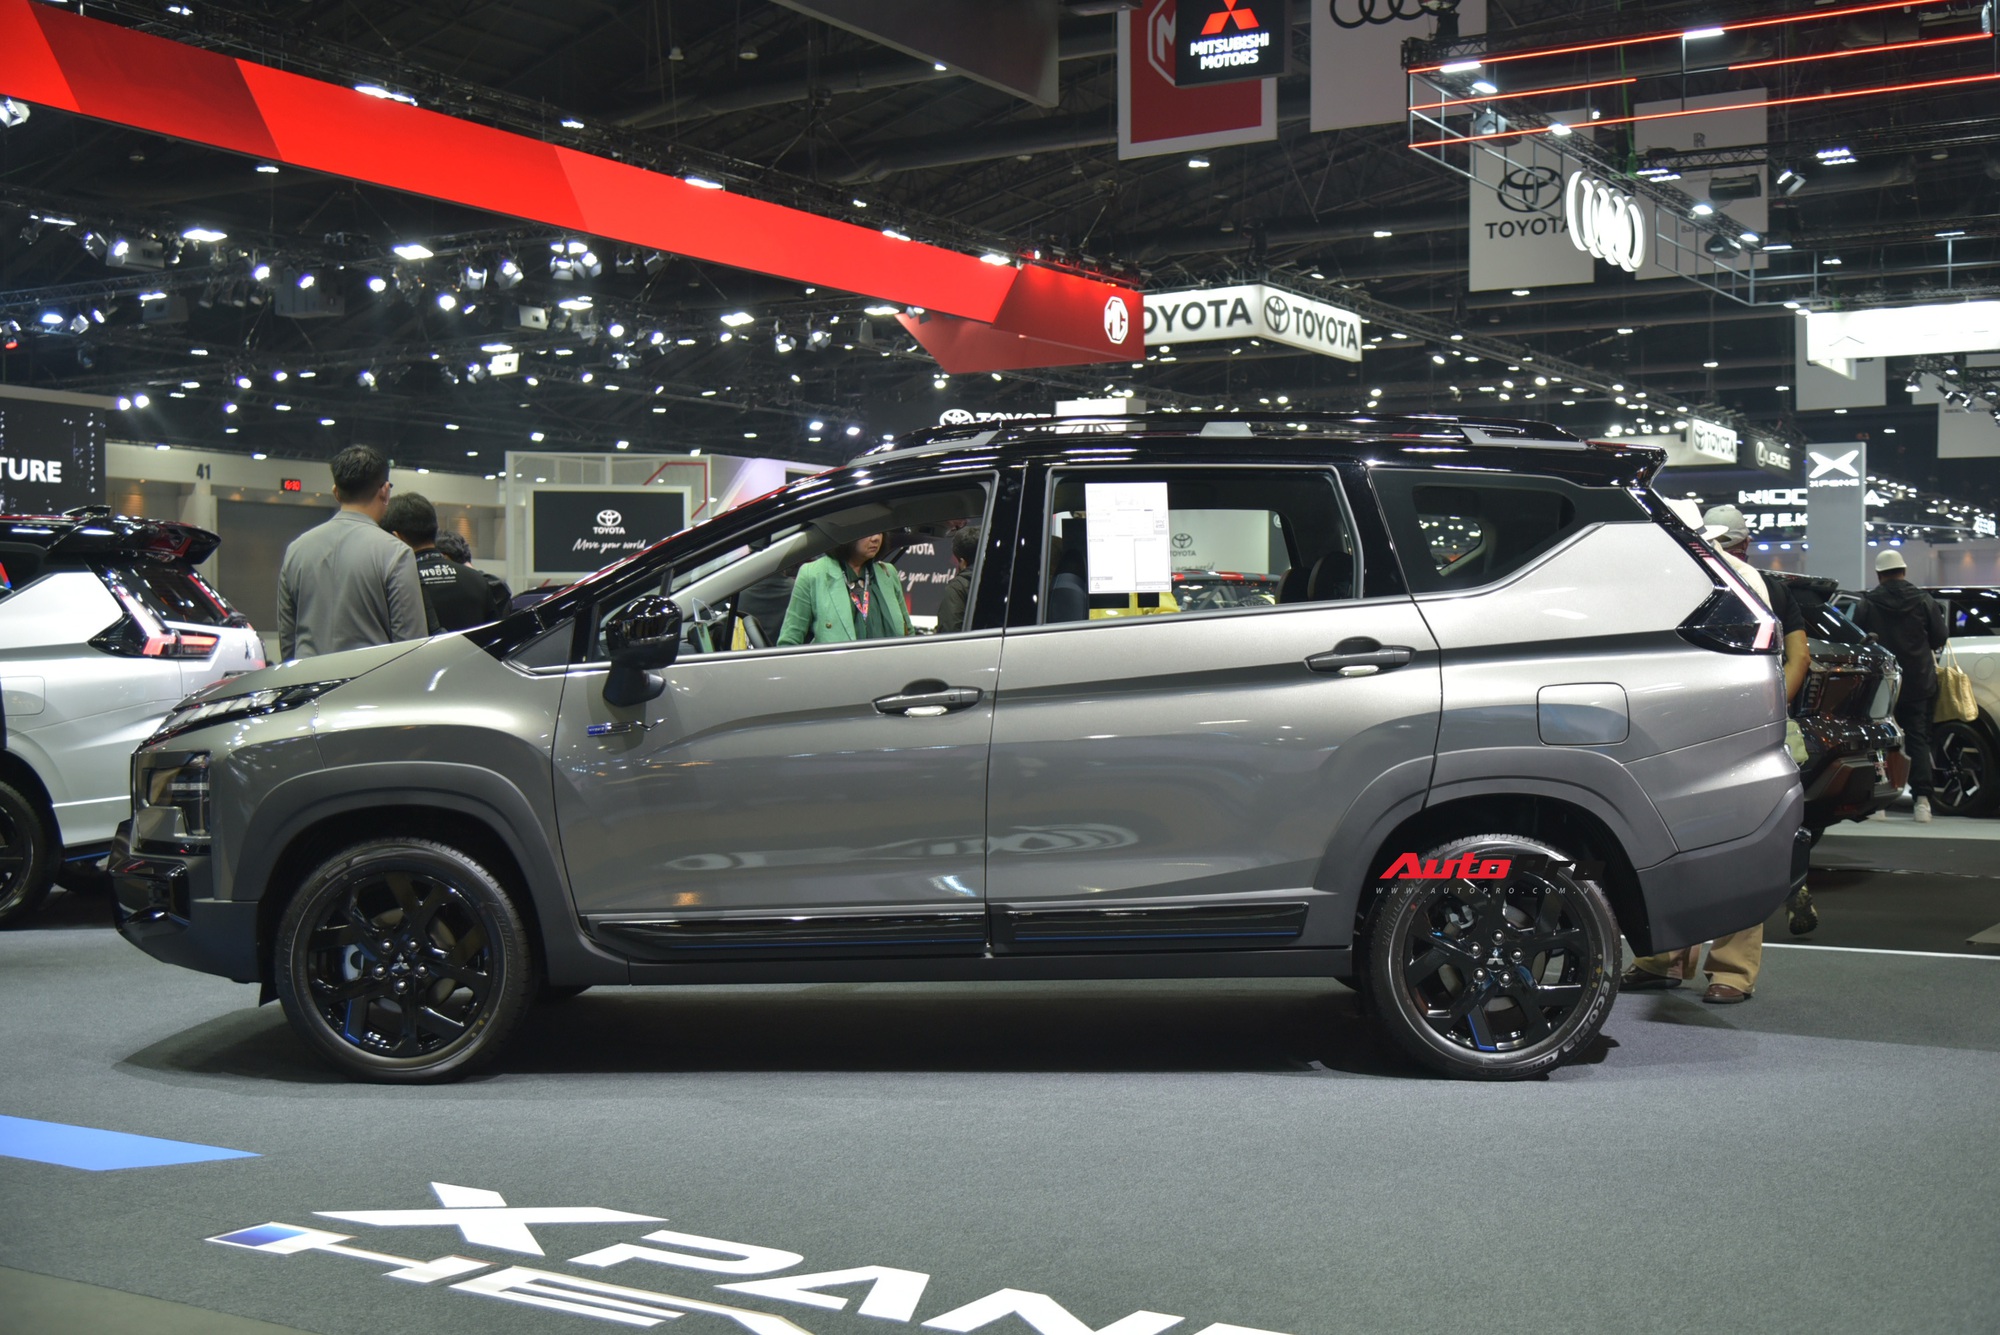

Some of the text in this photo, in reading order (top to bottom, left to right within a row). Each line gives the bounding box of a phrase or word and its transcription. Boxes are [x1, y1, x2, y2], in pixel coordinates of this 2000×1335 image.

[1190, 33, 1270, 56] MITSUBISHI
[1201, 50, 1259, 70] MOTORS
[1144, 298, 1253, 335] OYOTA
[1293, 306, 1358, 351] TOYOTA
[1707, 431, 1735, 456] TOYOTA
[1766, 450, 1791, 470] LEXUS
[196, 463, 211, 479] 41
[1809, 479, 1860, 488] XPENG
[593, 526, 626, 535] TOYOTA
[1742, 512, 1809, 531] ZEEK
[572, 538, 647, 554] Move your world
[905, 543, 935, 556] OYOTA
[419, 564, 457, 577] พจอีจัน
[908, 570, 930, 592] your
[932, 567, 957, 584] world
